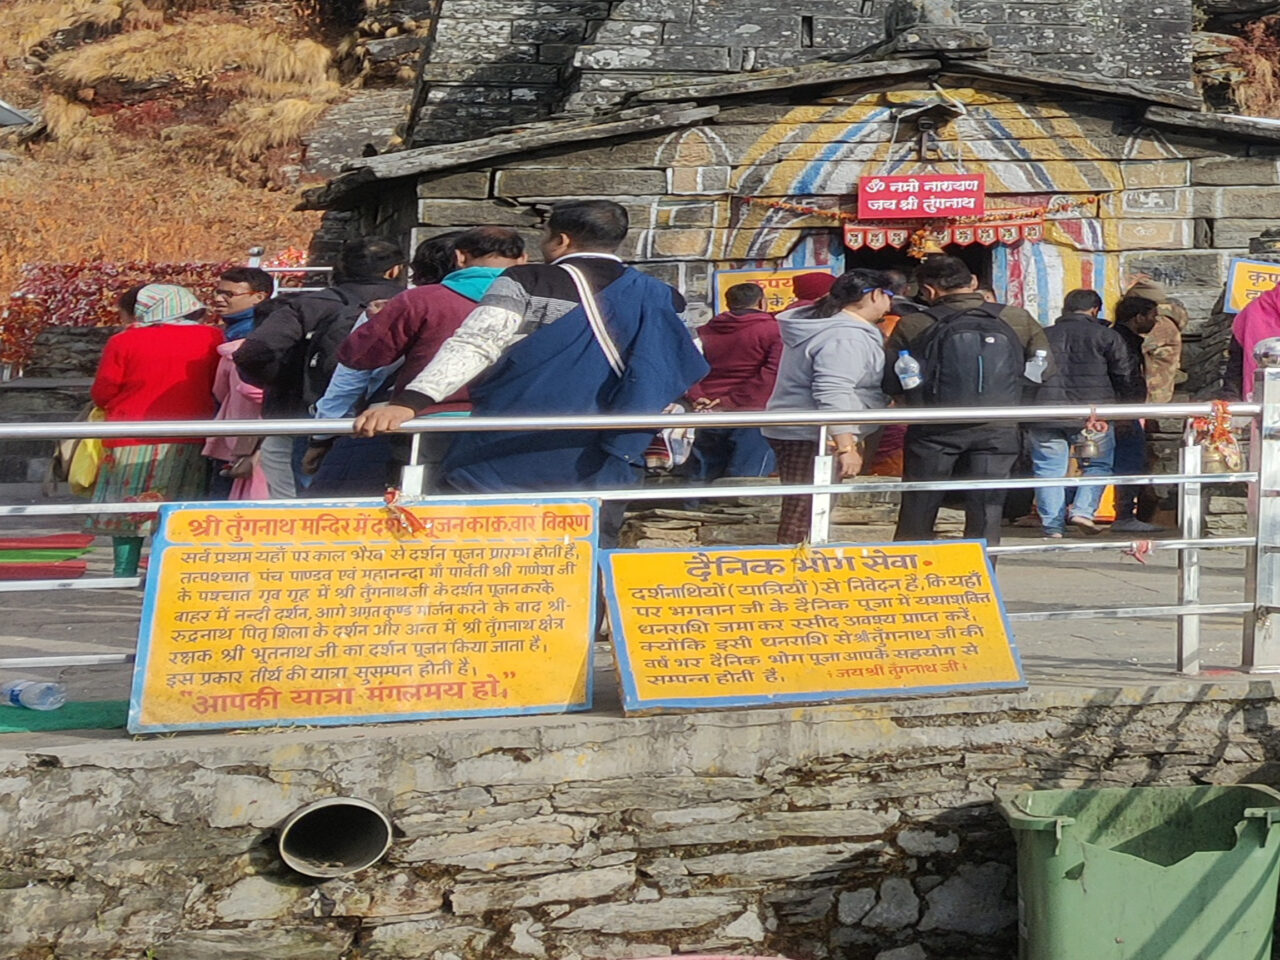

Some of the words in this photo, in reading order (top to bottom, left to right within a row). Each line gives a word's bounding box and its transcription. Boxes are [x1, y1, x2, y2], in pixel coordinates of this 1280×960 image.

[865, 179, 885, 192] ॐ
[890, 179, 920, 192] नमो
[924, 180, 979, 191] नारायण
[868, 199, 897, 210] जय
[899, 198, 919, 210] श्री
[923, 197, 975, 213] तुंगनाथ
[188, 514, 223, 536] श्री
[225, 513, 298, 542] तुँगनाथ
[299, 514, 354, 536] मन्दिर
[353, 513, 371, 535] में
[541, 512, 591, 532] विवरण
[180, 548, 210, 564] सर्व
[213, 551, 253, 564] प्रथम
[254, 547, 286, 563] यहाँ
[292, 550, 311, 562] पर
[312, 549, 345, 562] काल
[391, 545, 405, 560] से
[408, 546, 446, 560] दर्शन
[451, 547, 486, 564] पूजन
[489, 547, 530, 560] प्रारम्भ
[533, 545, 563, 558] होती
[684, 552, 787, 582] दैनिक
[791, 549, 856, 574] भोग
[862, 549, 919, 573] सेवा
[180, 572, 250, 585] तत्पश्चात
[257, 569, 285, 582] पंच
[337, 566, 357, 581] एवं
[362, 567, 425, 580] महानन्दा
[428, 563, 444, 578] माँ
[449, 563, 489, 577] पार्वती
[492, 562, 513, 577] श्री
[517, 563, 554, 576] गणेश
[557, 562, 577, 575] जी
[821, 579, 841, 594] से
[844, 577, 901, 593] निवेदन
[925, 573, 947, 589] कि
[948, 570, 983, 589] यहाँ
[177, 588, 192, 603] के
[197, 590, 253, 602] पश्चात
[286, 588, 310, 603] गृह
[316, 584, 331, 599] में
[335, 584, 356, 599] श्री
[360, 583, 409, 603] तुँगनाथ
[409, 583, 429, 598] जी
[433, 582, 448, 597] के
[450, 583, 482, 597] दर्शन
[488, 583, 519, 599] पूजन
[520, 579, 556, 595] करके
[215, 607, 230, 622] में
[235, 606, 271, 622] नन्दी
[315, 604, 347, 619] आगे
[350, 606, 381, 620] अमृत
[382, 605, 414, 623] कुण्ड
[457, 601, 488, 615] करने
[493, 600, 510, 614] के
[632, 606, 663, 618] पर
[668, 605, 736, 617] भगवान
[740, 601, 765, 614] जी
[769, 599, 789, 614] के
[795, 597, 849, 613] दैनिक
[854, 598, 895, 612] पूजा
[895, 594, 912, 607] में
[915, 591, 992, 606] यथाशक्ति
[170, 627, 236, 643] रुद्रनाथ
[272, 623, 311, 640] शिला
[312, 622, 331, 639] के
[332, 621, 368, 639] दर्शन
[405, 623, 437, 636] अन्त
[443, 618, 458, 633] में
[462, 618, 482, 633] श्री
[485, 617, 535, 638] तुँगनाथ
[539, 614, 567, 631] क्षेत्र
[638, 620, 710, 635] धनराशि
[714, 620, 756, 633] जमा
[757, 620, 785, 631] कर
[791, 613, 839, 631] रसीद
[843, 614, 897, 627] अवश्य
[899, 612, 940, 624] प्राप्त
[715, 636, 752, 652] इसी
[760, 631, 829, 646] धनराशि
[833, 631, 853, 645] से
[935, 625, 960, 639] जी
[960, 624, 986, 639] की
[168, 649, 214, 665] रक्षक
[221, 644, 246, 663] श्री
[251, 647, 313, 665] भूतनाथ
[314, 642, 340, 658] जी
[343, 644, 366, 657] का
[368, 641, 408, 657] दर्शन
[413, 642, 448, 658] पूजन
[452, 638, 488, 654] किया
[492, 639, 525, 653] जाता
[643, 655, 672, 669] वर्ष
[674, 658, 705, 668] भर
[710, 653, 762, 668] दैनिक
[767, 651, 806, 665] भोग
[808, 652, 841, 666] पूजा
[842, 648, 890, 663] आपके
[892, 645, 957, 660] सहयोग
[961, 642, 979, 655] से
[166, 672, 196, 689] इस
[199, 671, 246, 686] प्रकार
[250, 666, 285, 684] तीर्थ
[286, 664, 309, 681] की
[310, 666, 349, 680] यात्रा
[418, 660, 454, 678] होती
[646, 674, 711, 686] सम्पन्न
[714, 671, 757, 685] होती
[866, 663, 886, 676] श्री
[290, 687, 356, 707] यात्रा
[366, 681, 468, 703] मंगलमय
